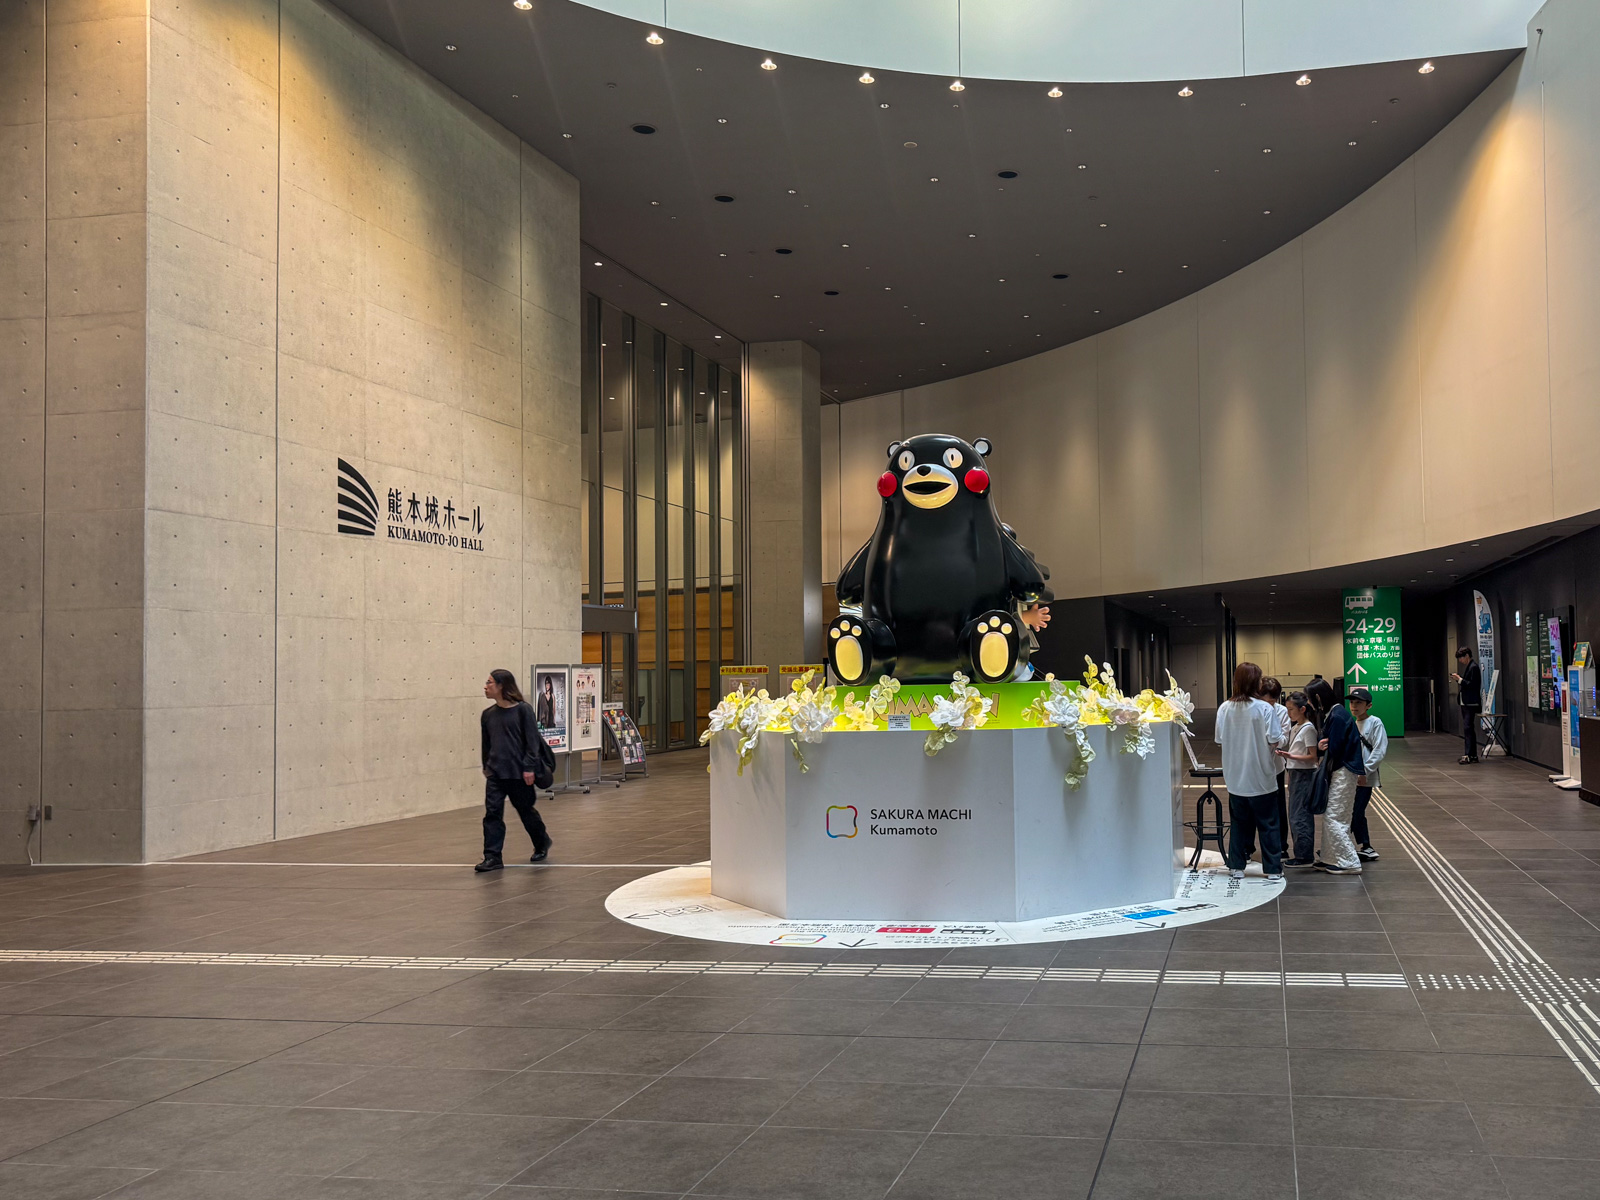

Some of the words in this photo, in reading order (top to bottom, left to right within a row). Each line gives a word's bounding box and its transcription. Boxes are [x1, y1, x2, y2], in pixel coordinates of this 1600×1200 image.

[388, 488, 484, 534] 熊本城ホール
[460, 537, 484, 551] HALL
[1345, 618, 1396, 634] 24-29
[870, 808, 925, 820] SAKURA
[927, 808, 972, 820] MACHI
[870, 824, 938, 836] Kumamoto
